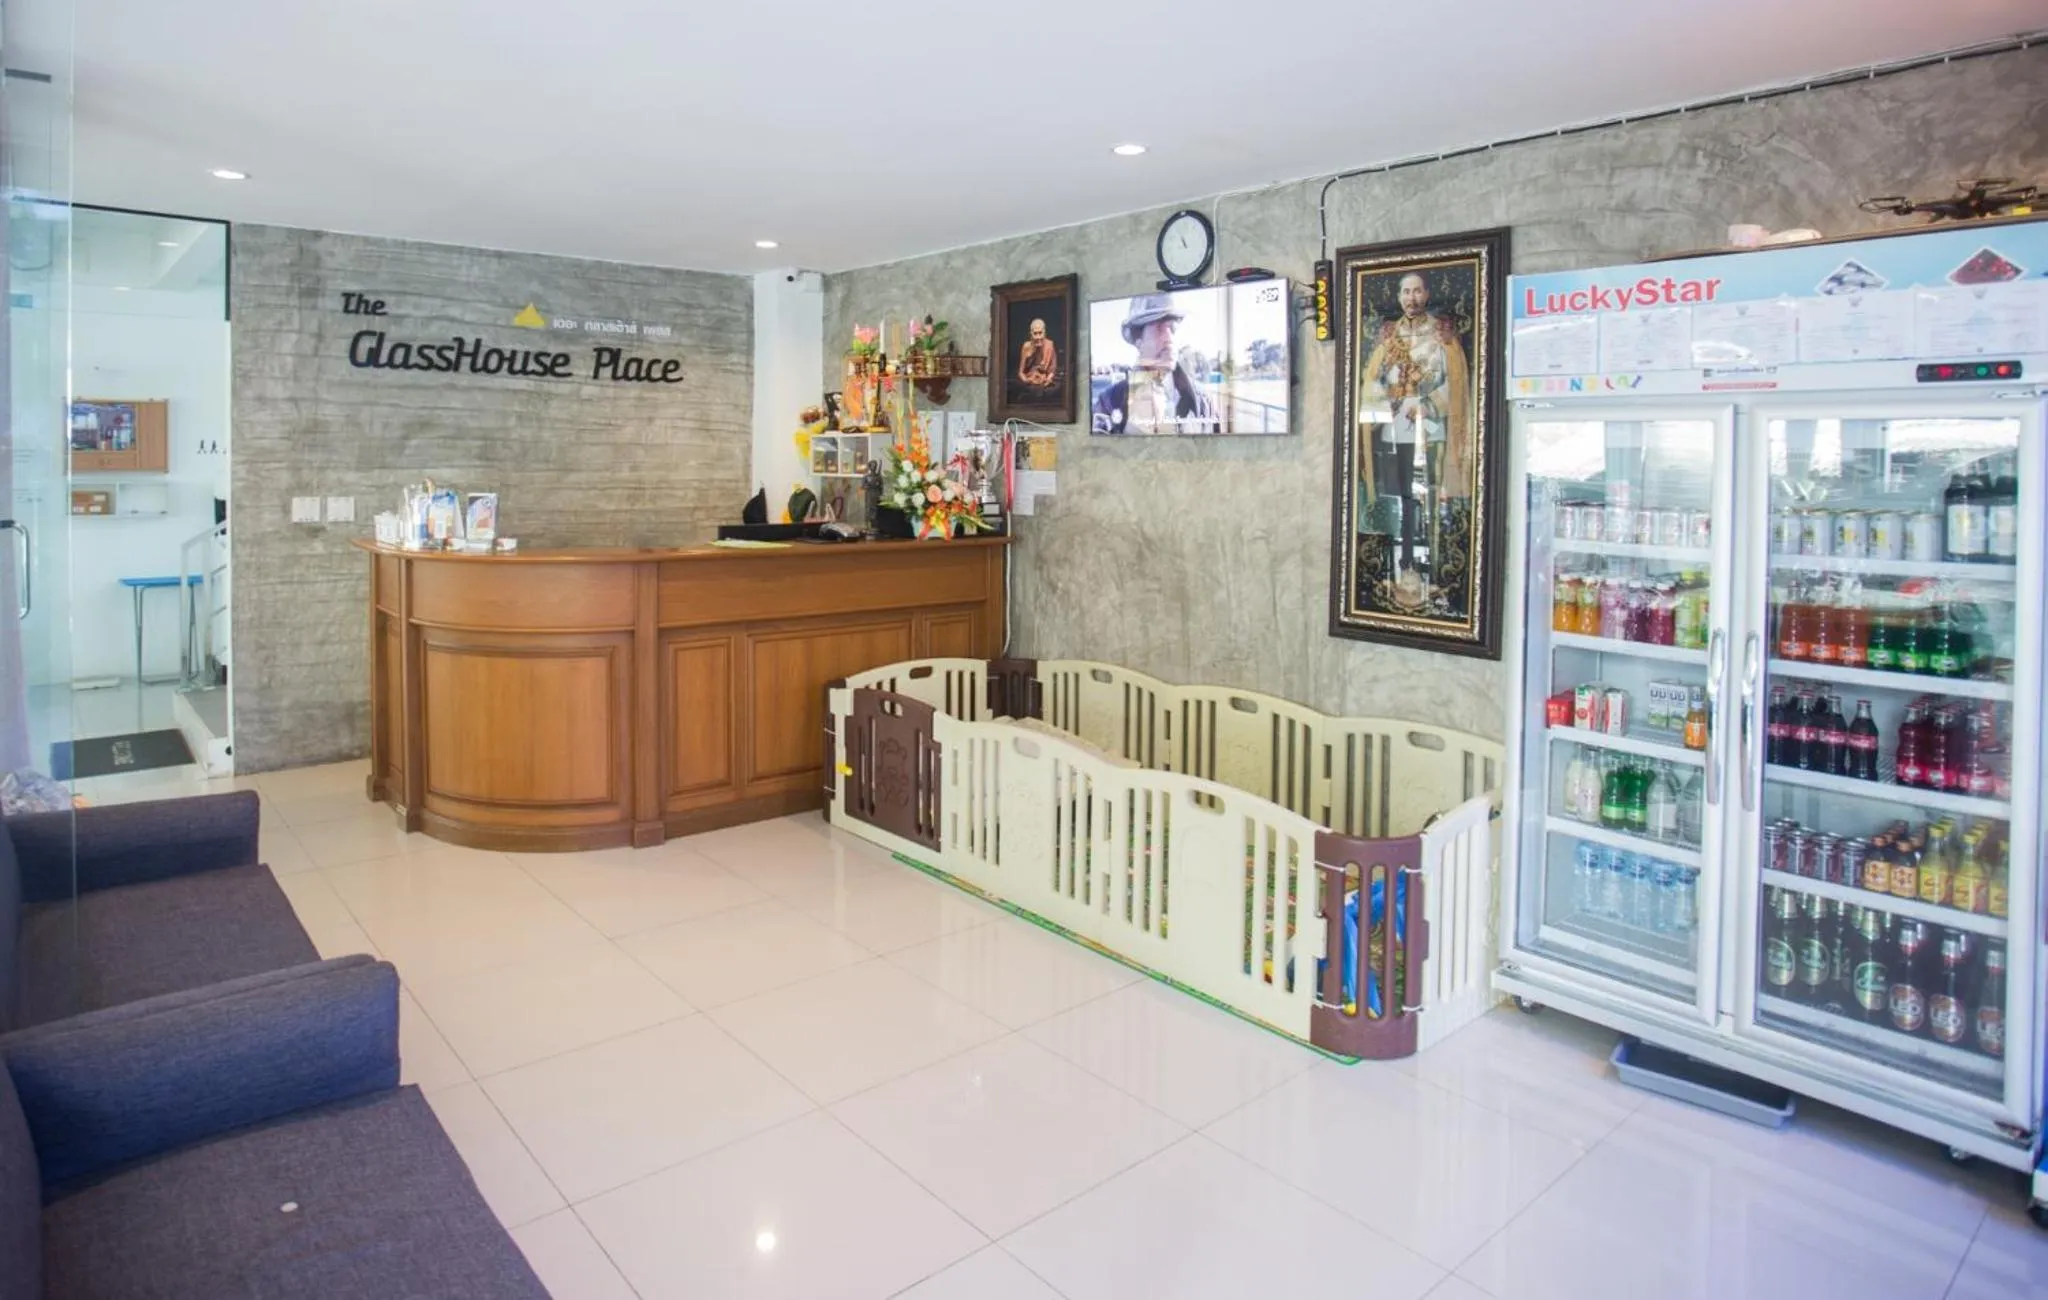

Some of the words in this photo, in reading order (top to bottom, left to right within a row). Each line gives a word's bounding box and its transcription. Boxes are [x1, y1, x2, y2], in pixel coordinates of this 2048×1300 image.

[341, 292, 388, 316] The
[1525, 276, 1722, 316] LuckyStar
[349, 330, 572, 378] GlassHouse
[592, 347, 684, 384] Place
